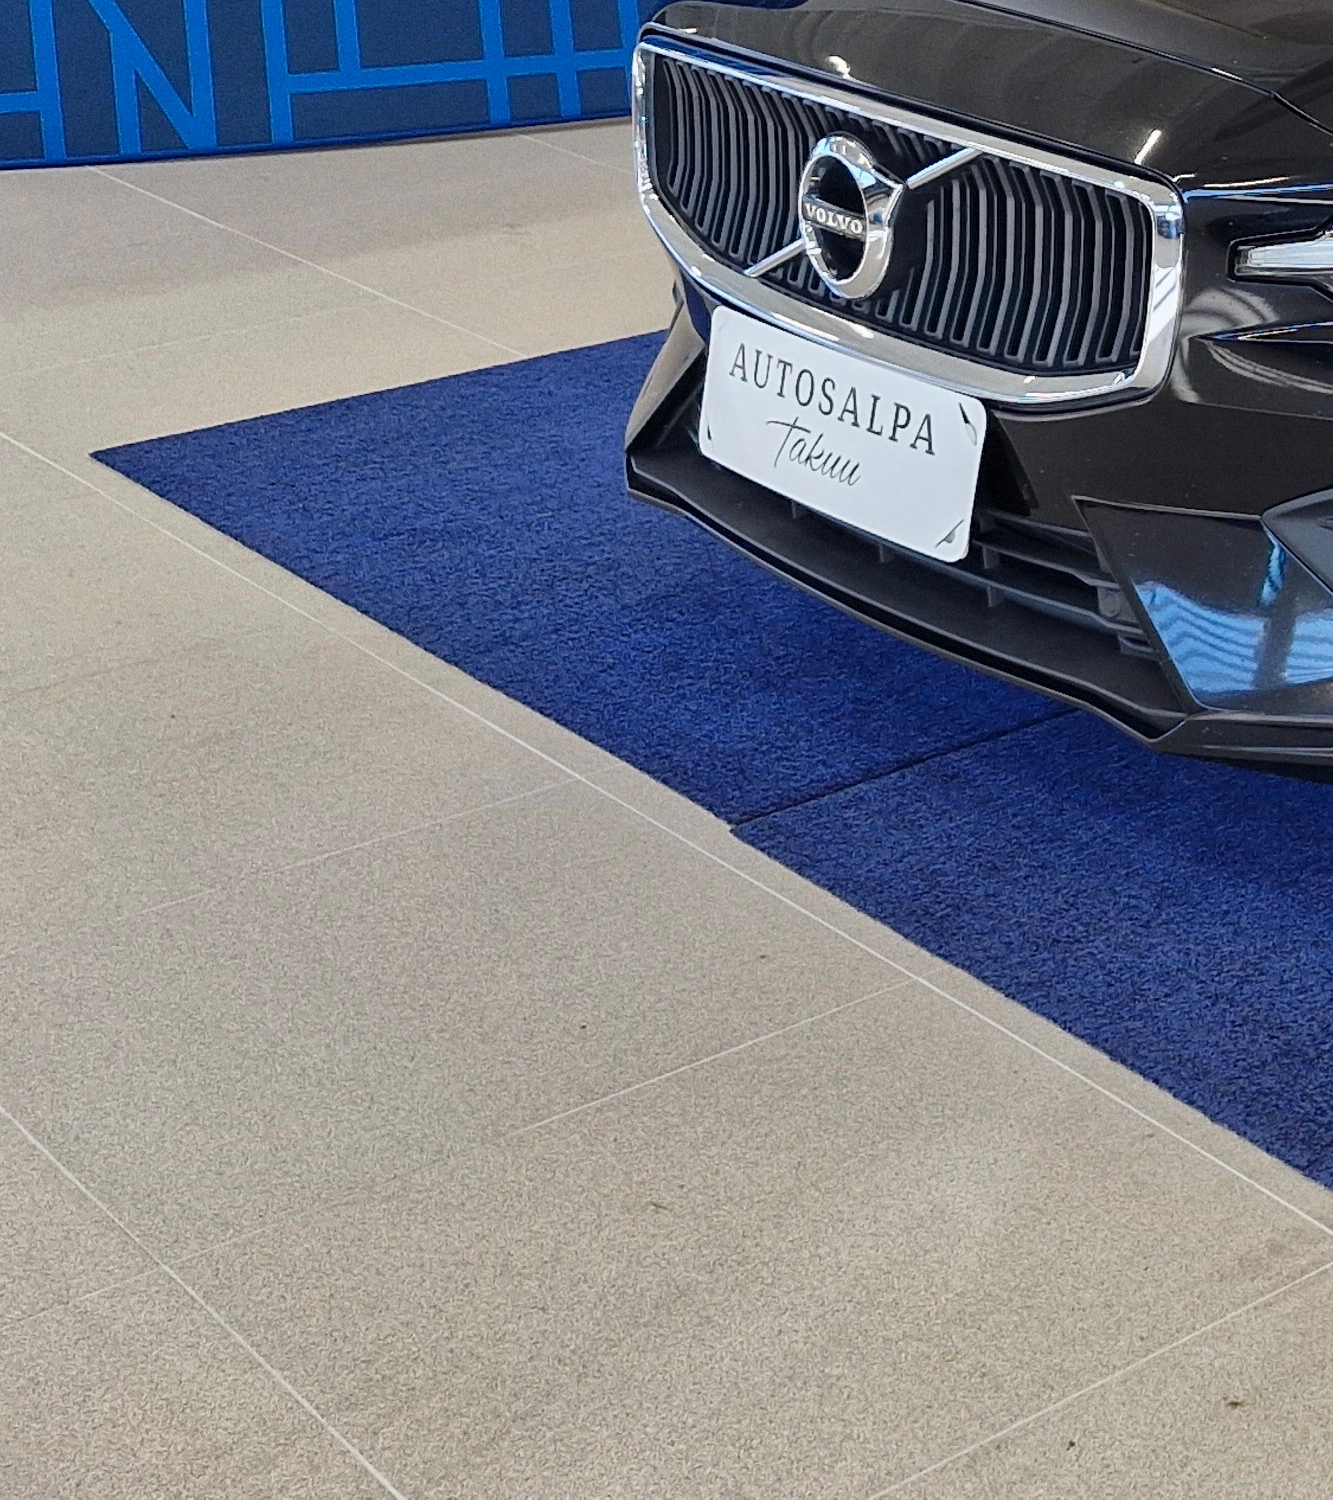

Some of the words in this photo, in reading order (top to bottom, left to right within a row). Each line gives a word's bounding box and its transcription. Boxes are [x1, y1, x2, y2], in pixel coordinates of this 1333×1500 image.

[804, 202, 864, 235] VOLVO
[728, 342, 936, 456] AUTOSALPA
[765, 416, 862, 487] Takuu
